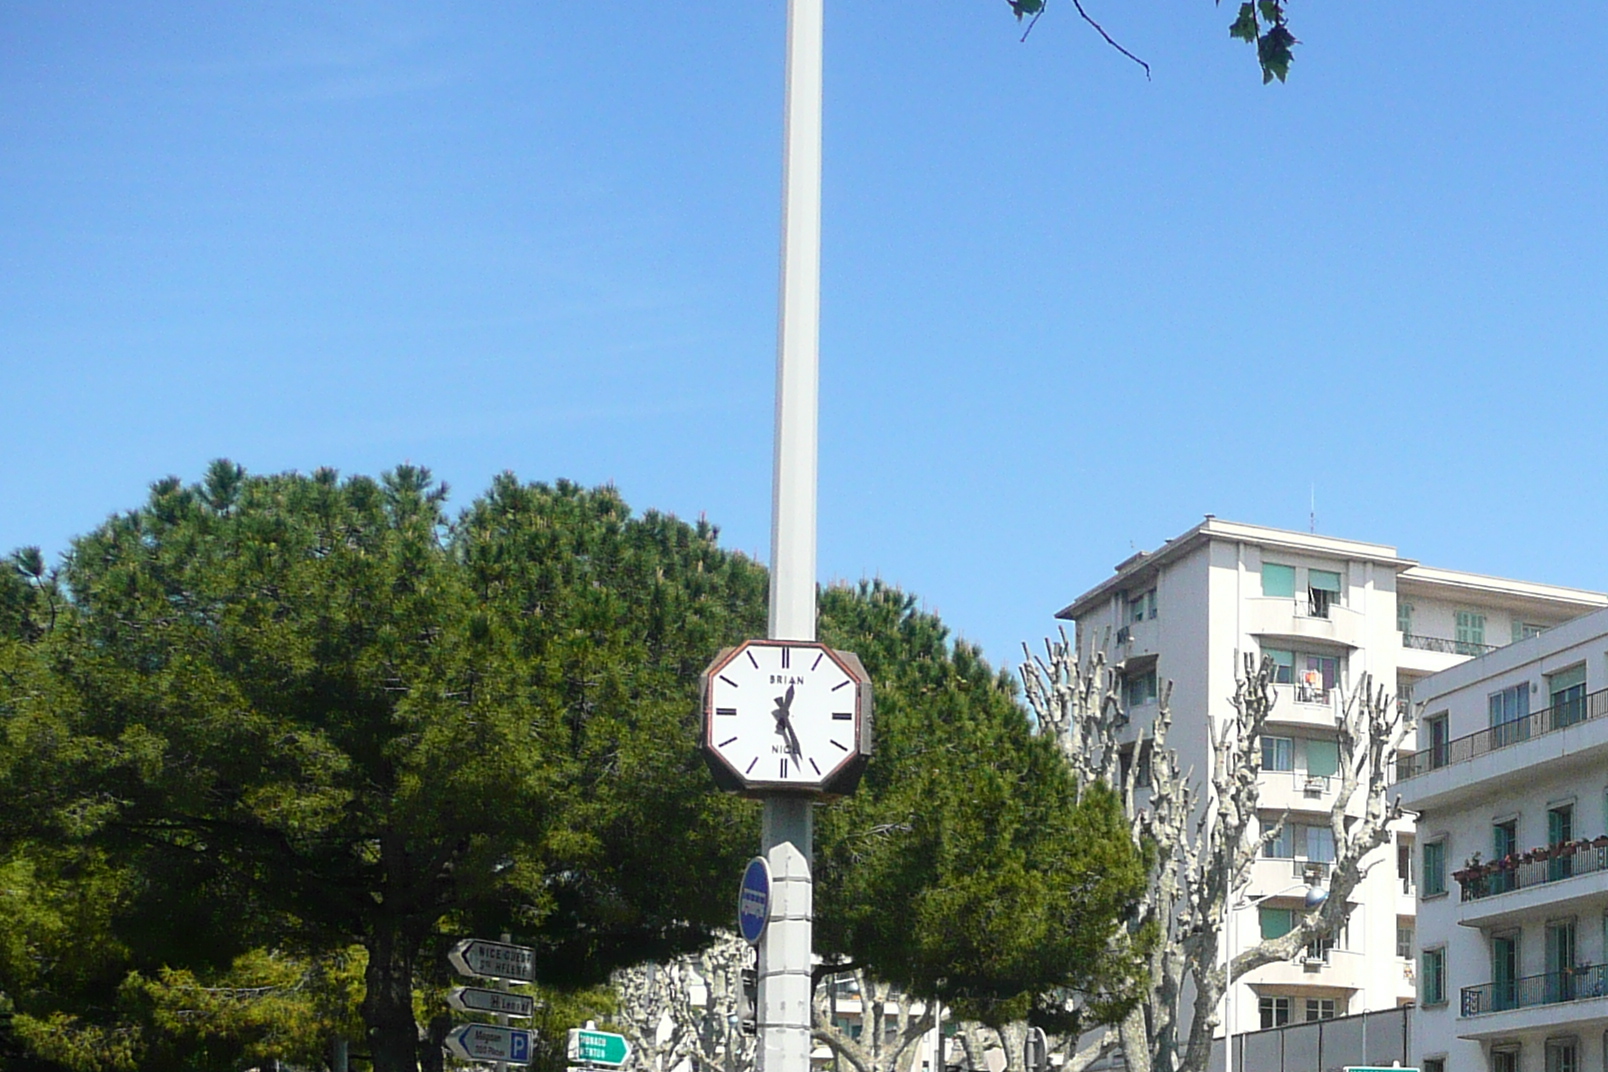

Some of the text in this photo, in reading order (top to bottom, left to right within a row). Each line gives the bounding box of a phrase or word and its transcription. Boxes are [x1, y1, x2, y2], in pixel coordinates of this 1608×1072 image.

[769, 675, 805, 685] BRIAN
[771, 744, 798, 754] NIC
[478, 946, 502, 959] NICE
